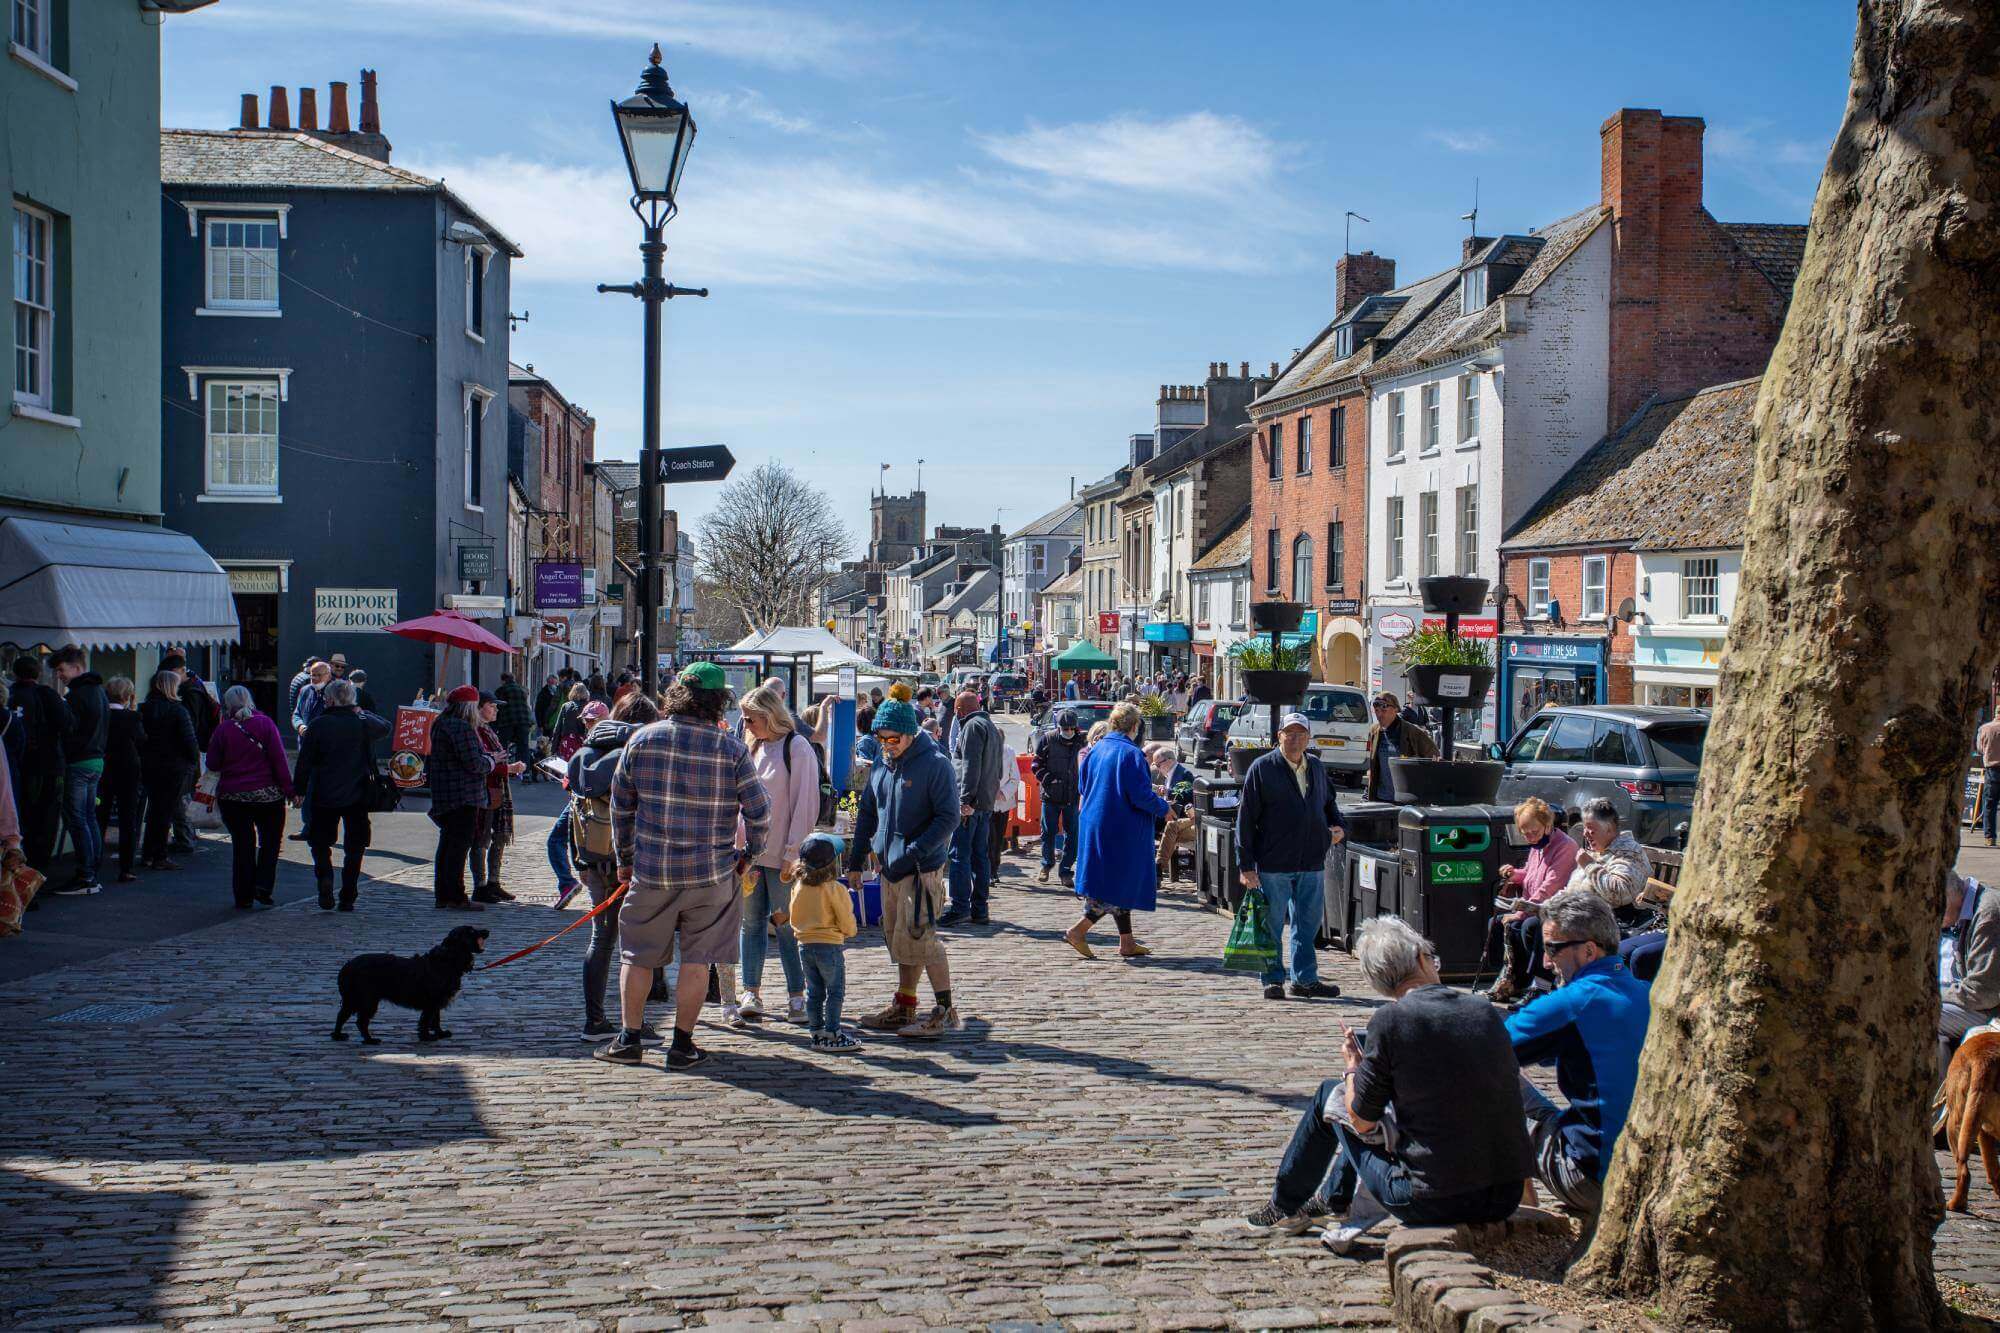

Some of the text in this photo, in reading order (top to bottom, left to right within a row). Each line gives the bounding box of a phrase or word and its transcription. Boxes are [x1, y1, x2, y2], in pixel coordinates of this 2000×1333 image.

[671, 459, 715, 470] Coach Station
[539, 573, 558, 581] Angel
[316, 595, 396, 609] BRIDPORT
[317, 611, 397, 626] Old BOOKS
[1543, 643, 1551, 655] BY
[1551, 644, 1564, 656] THE
[1565, 644, 1578, 657] SEA
